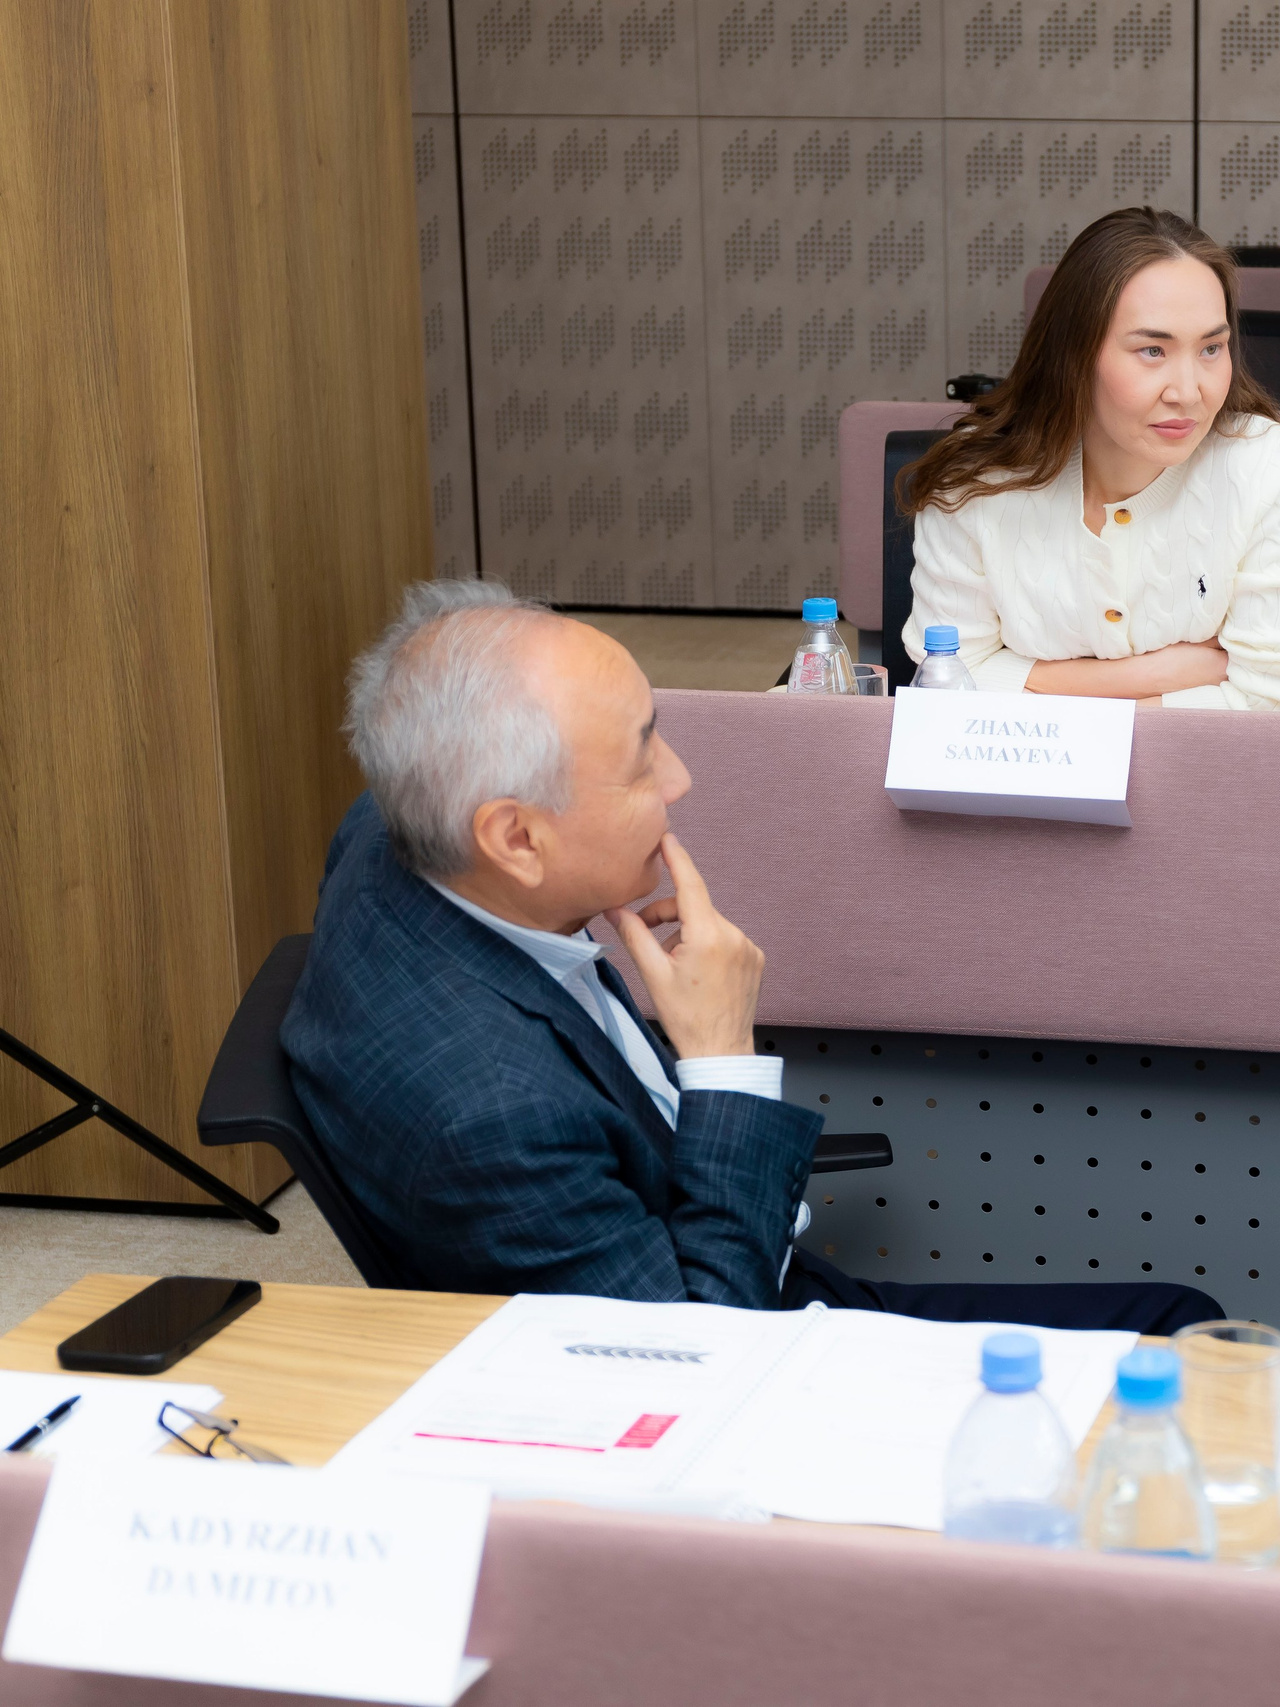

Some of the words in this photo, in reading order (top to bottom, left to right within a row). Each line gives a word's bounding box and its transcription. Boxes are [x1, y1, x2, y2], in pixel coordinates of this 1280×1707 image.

[964, 718, 1060, 739] ZHANAR
[944, 744, 1073, 765] SAMAYEVA
[128, 1509, 393, 1562] KADYRZHAN
[146, 1564, 350, 1610] DAMITOV
